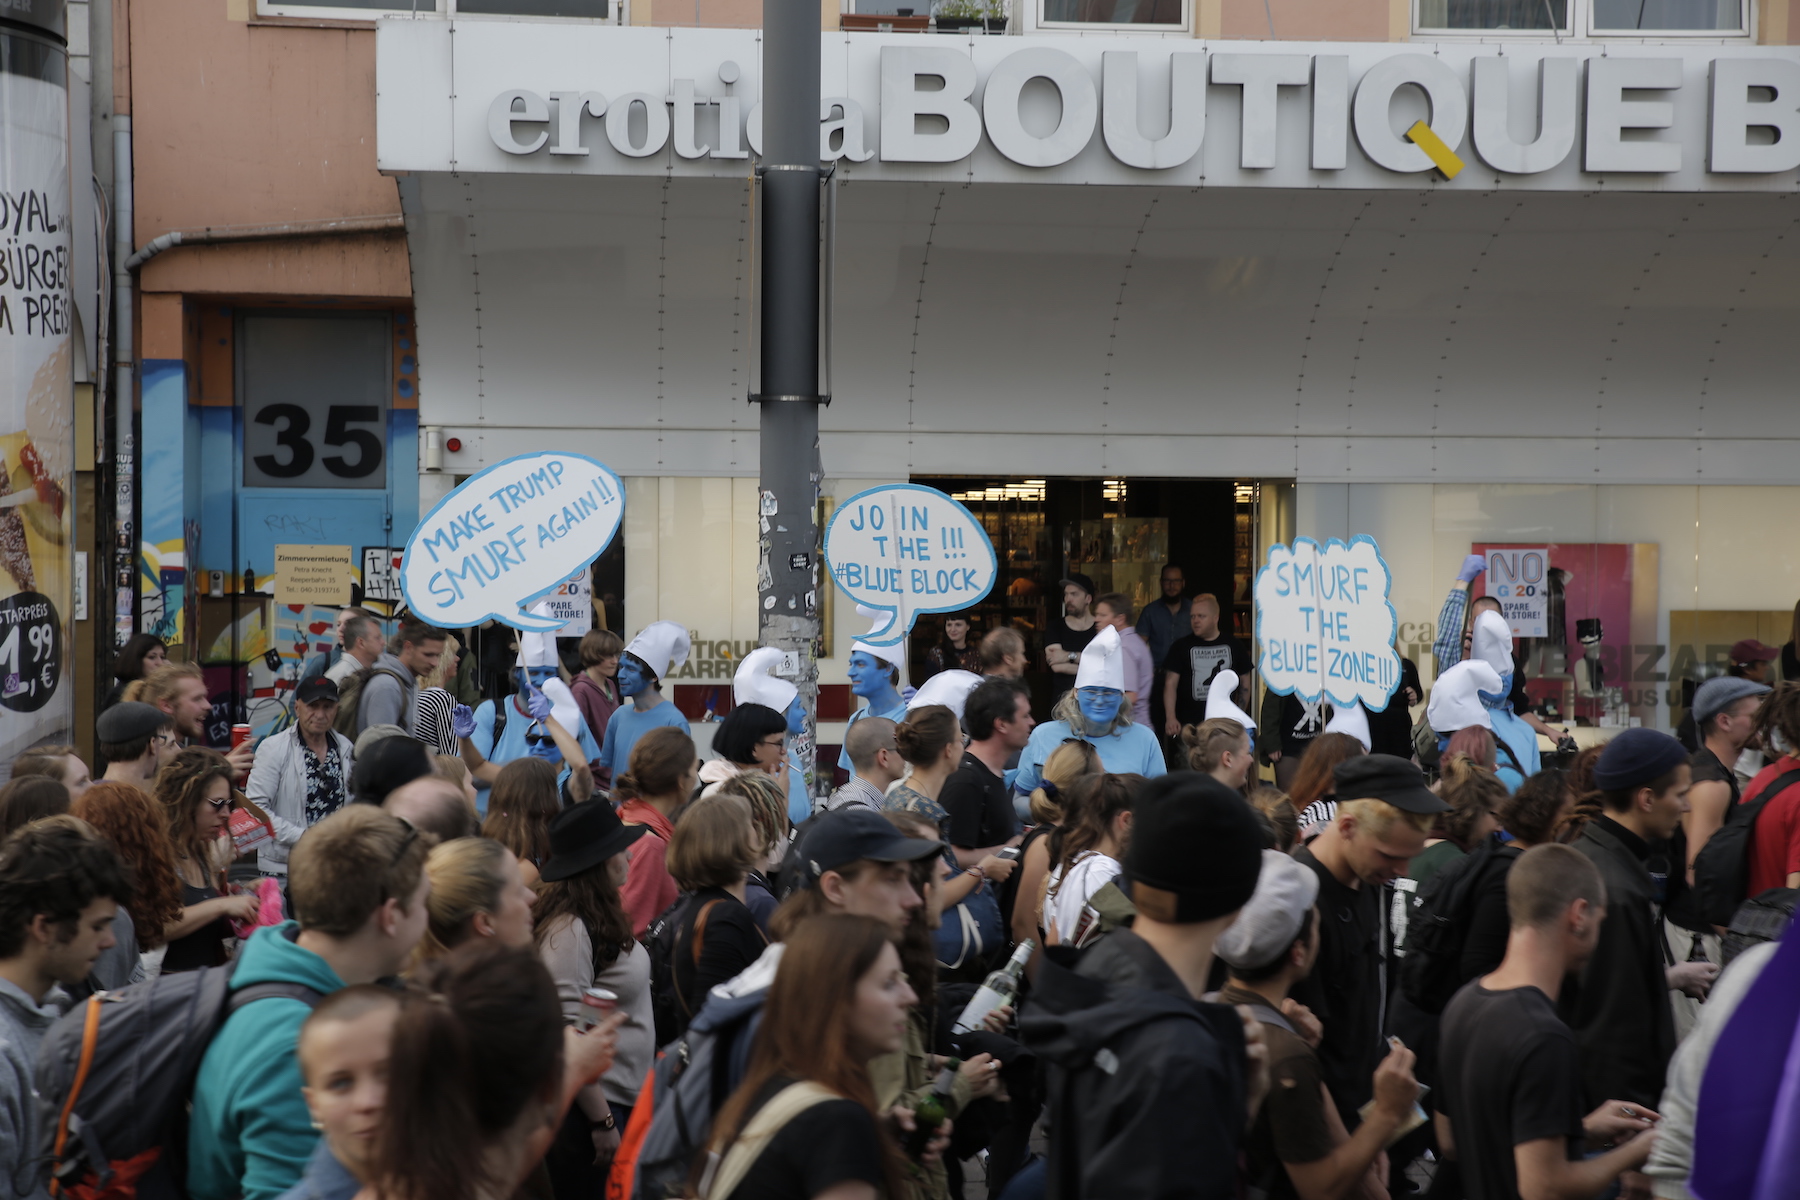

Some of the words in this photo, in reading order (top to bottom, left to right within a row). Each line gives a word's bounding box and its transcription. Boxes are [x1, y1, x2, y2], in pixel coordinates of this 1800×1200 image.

[488, 60, 874, 163] erotia
[880, 46, 1684, 181] BOUTIQUE
[1708, 58, 1800, 173] B
[253, 404, 382, 478] 35
[422, 503, 495, 563] MAKE
[489, 460, 564, 514] TRUMP
[428, 524, 527, 608] SMURF
[536, 475, 616, 548] AGAIN!!
[873, 536, 930, 561] THE
[278, 555, 349, 564] Zimmervermietung
[1491, 552, 1543, 584] NO
[290, 577, 327, 585] Reeperbahn
[558, 583, 578, 595] 20
[835, 562, 902, 594] #BLUE
[911, 568, 981, 595] BLOCK
[1275, 561, 1368, 604] SMURF
[1515, 585, 1535, 597] 20
[554, 610, 584, 618] STORE!
[1299, 607, 1350, 641] THE
[1512, 611, 1540, 619] STORE!
[1270, 639, 1317, 673] BLUE
[1328, 648, 1393, 690] ZONE!!!
